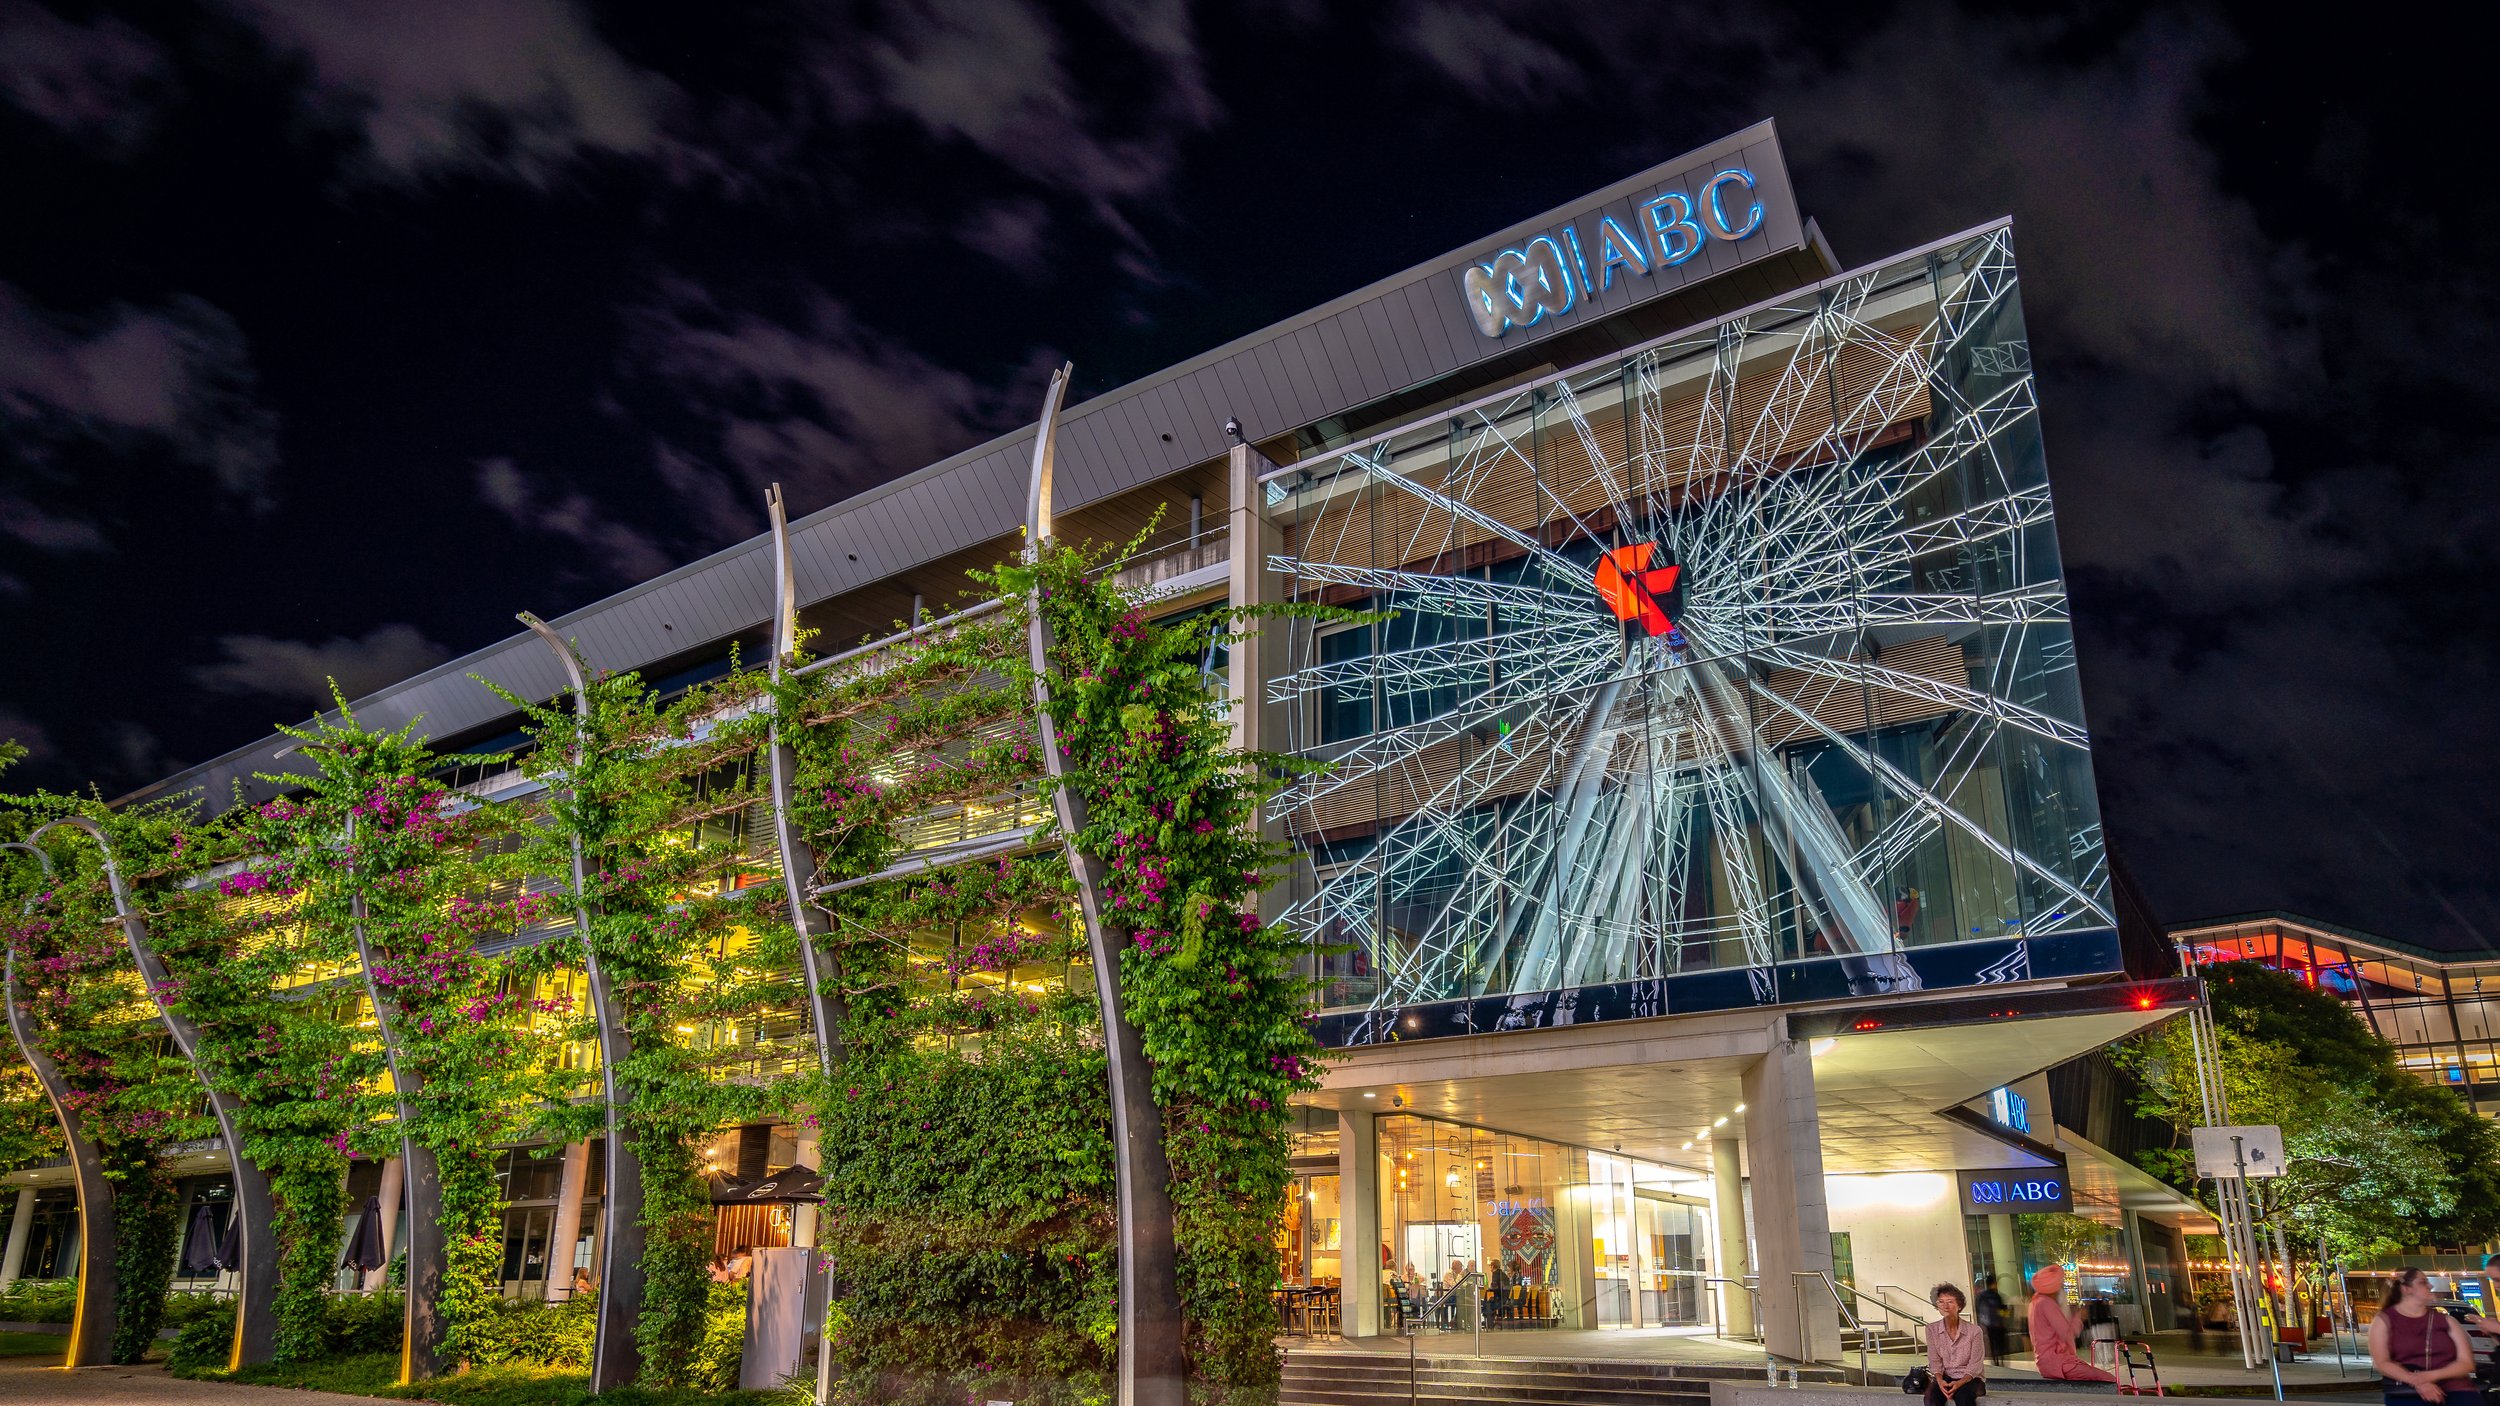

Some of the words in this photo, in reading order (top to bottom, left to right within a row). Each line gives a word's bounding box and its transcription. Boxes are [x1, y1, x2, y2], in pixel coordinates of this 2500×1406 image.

[1600, 169, 1762, 291] ABC
[2010, 1091, 2030, 1134] ABC
[2011, 1181, 2060, 1201] ABC
